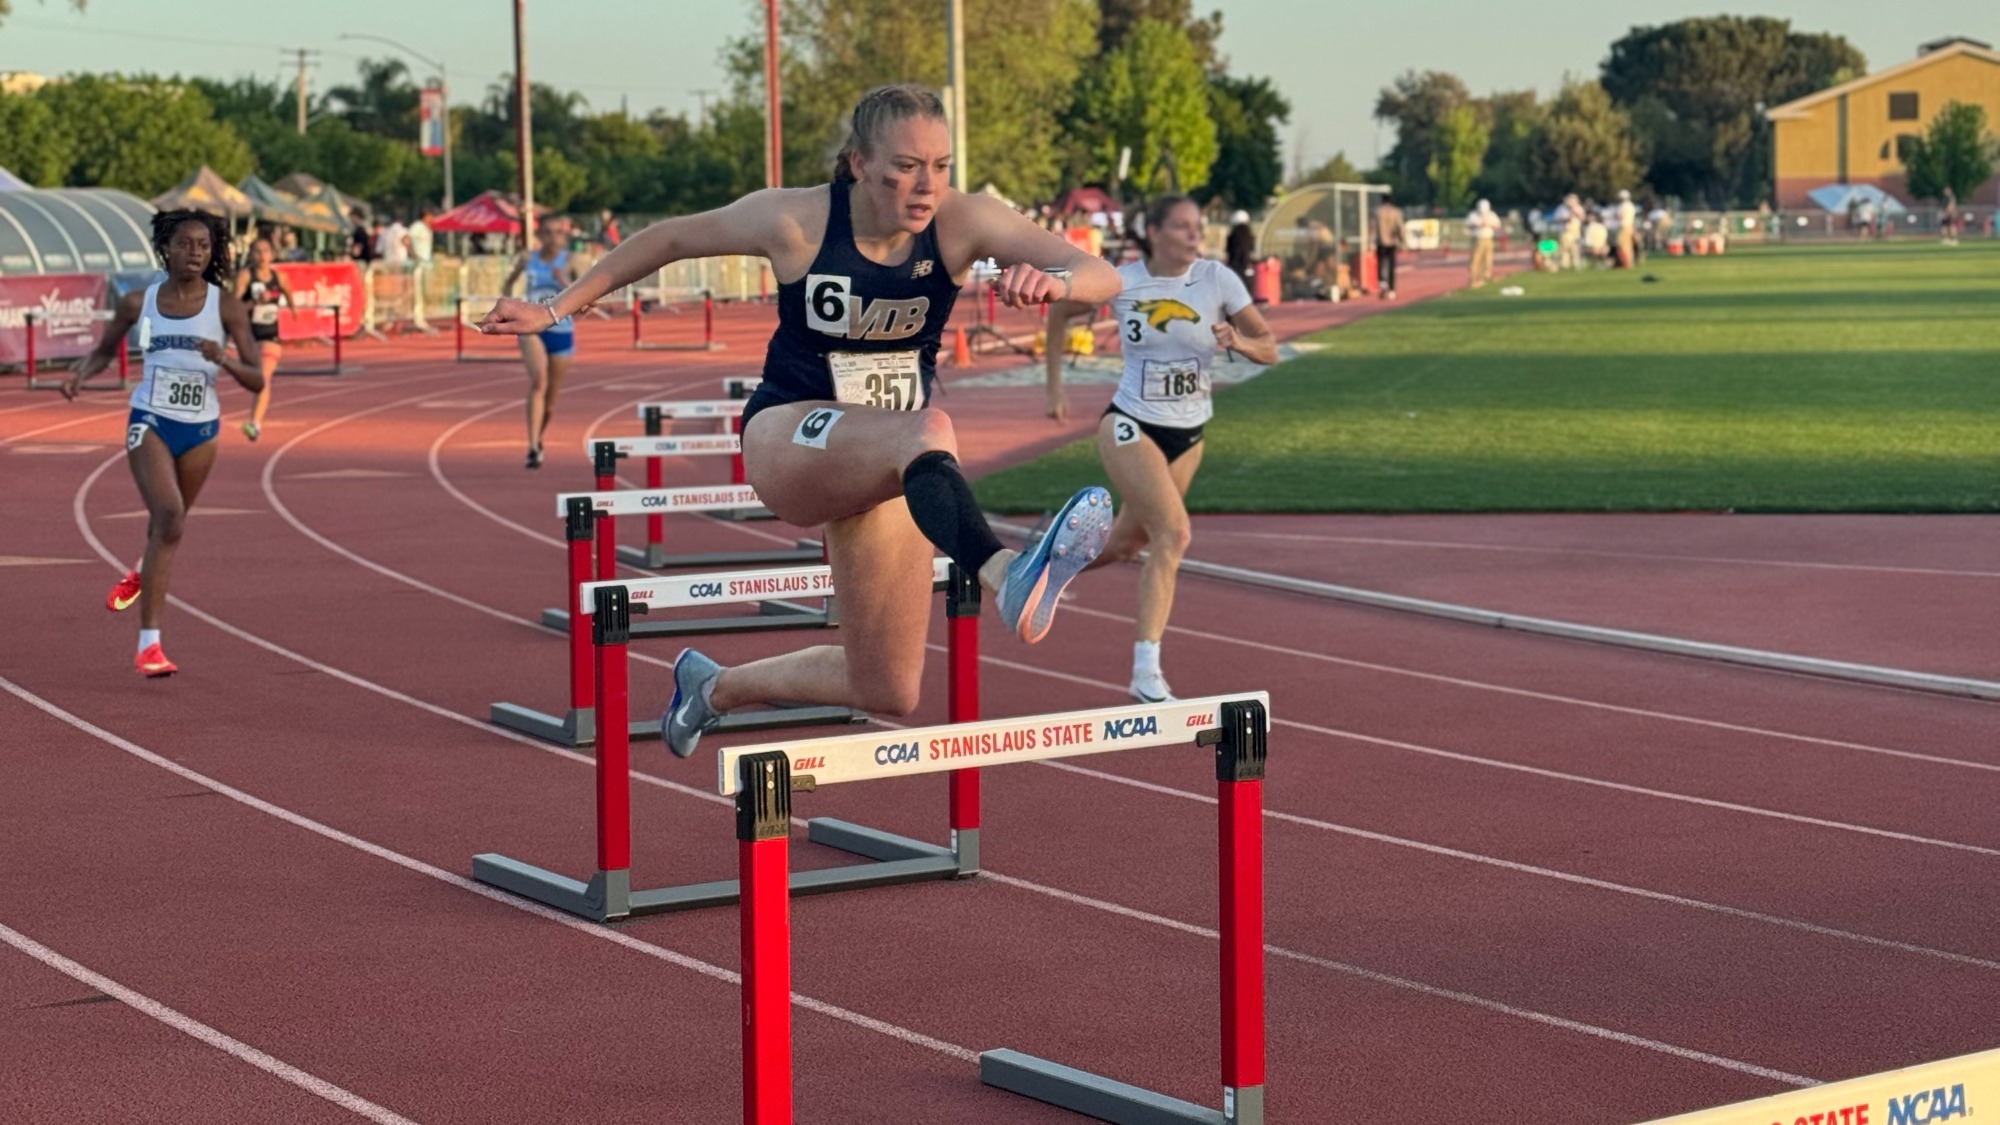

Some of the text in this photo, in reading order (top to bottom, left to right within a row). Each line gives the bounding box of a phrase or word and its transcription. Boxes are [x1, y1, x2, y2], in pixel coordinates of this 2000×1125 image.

[812, 281, 845, 322] 6
[1126, 319, 1143, 343] 3
[168, 382, 203, 407] 366
[865, 372, 917, 410] 357
[1163, 373, 1197, 396] 163
[129, 426, 141, 446] 5
[1117, 422, 1135, 442] 3
[672, 491, 734, 506] STANISLAUS
[631, 590, 654, 600] GILL
[689, 582, 722, 598] CCAA
[729, 575, 808, 596] STANISLAUS
[793, 713, 1214, 771] GILL CCAA STANISLAUS STATE NCAA GILL
[1887, 1083, 1966, 1125] NCAA
